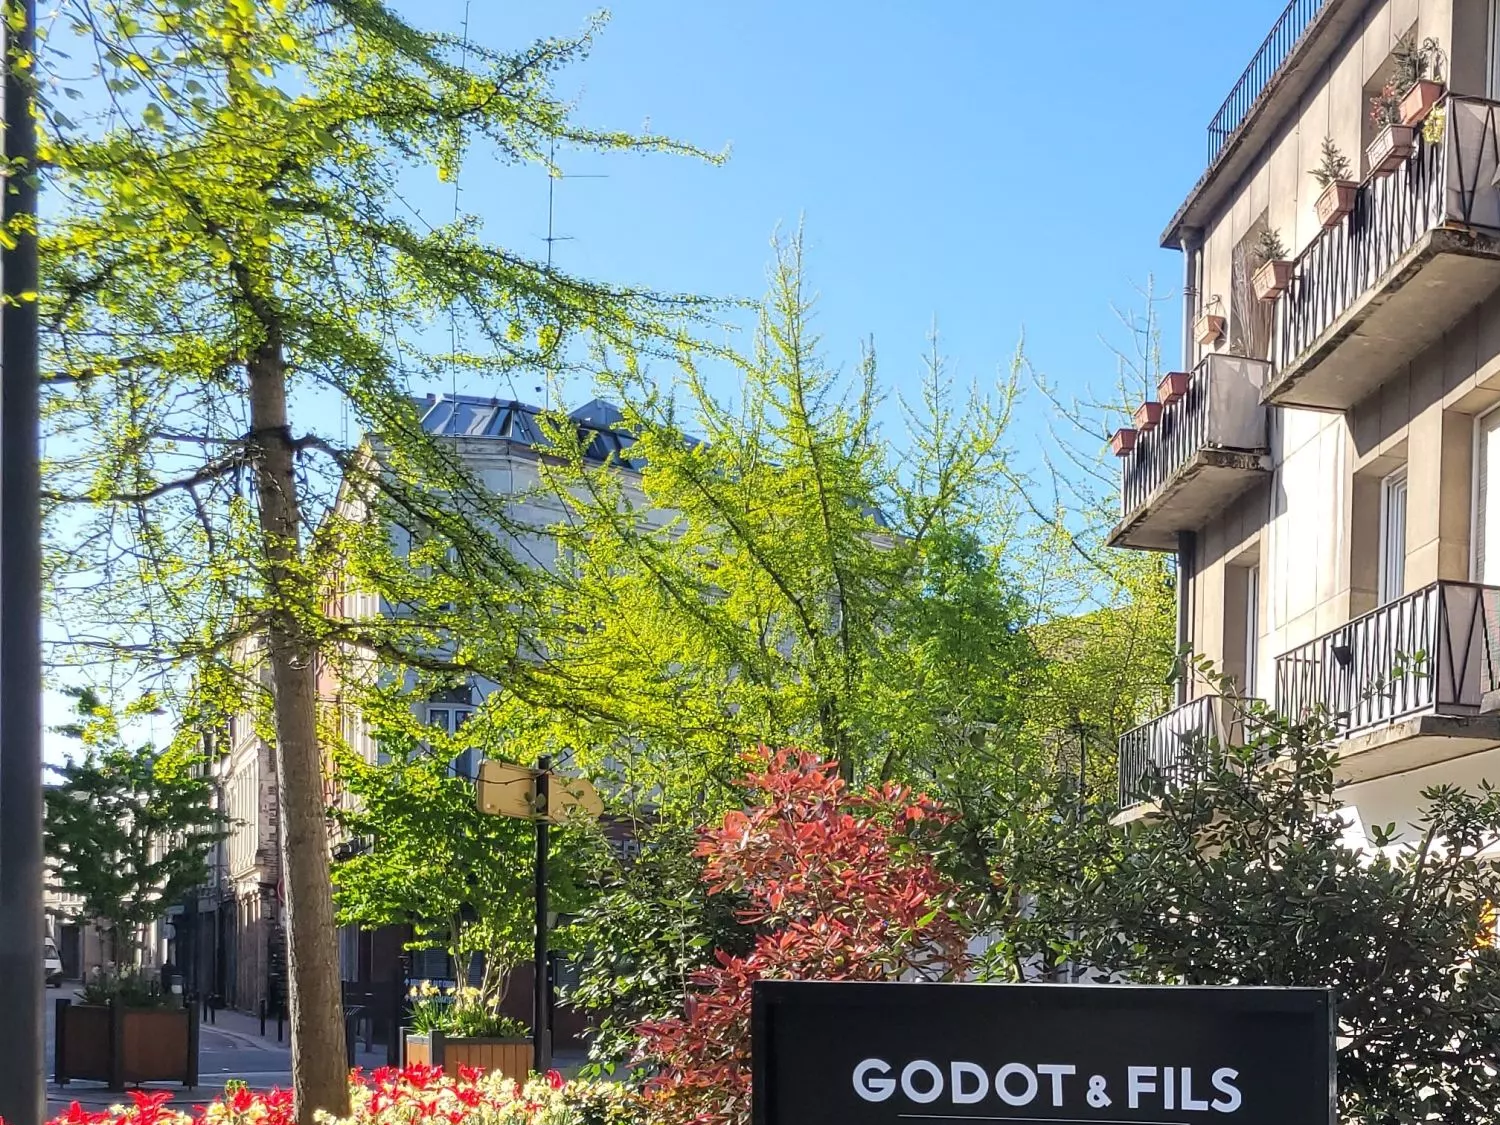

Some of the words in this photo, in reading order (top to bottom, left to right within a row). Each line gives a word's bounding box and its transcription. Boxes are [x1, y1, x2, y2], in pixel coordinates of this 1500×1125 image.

[852, 1058, 1076, 1107] GODOT
[1086, 1074, 1112, 1108] &
[1127, 1065, 1243, 1114] FILS
